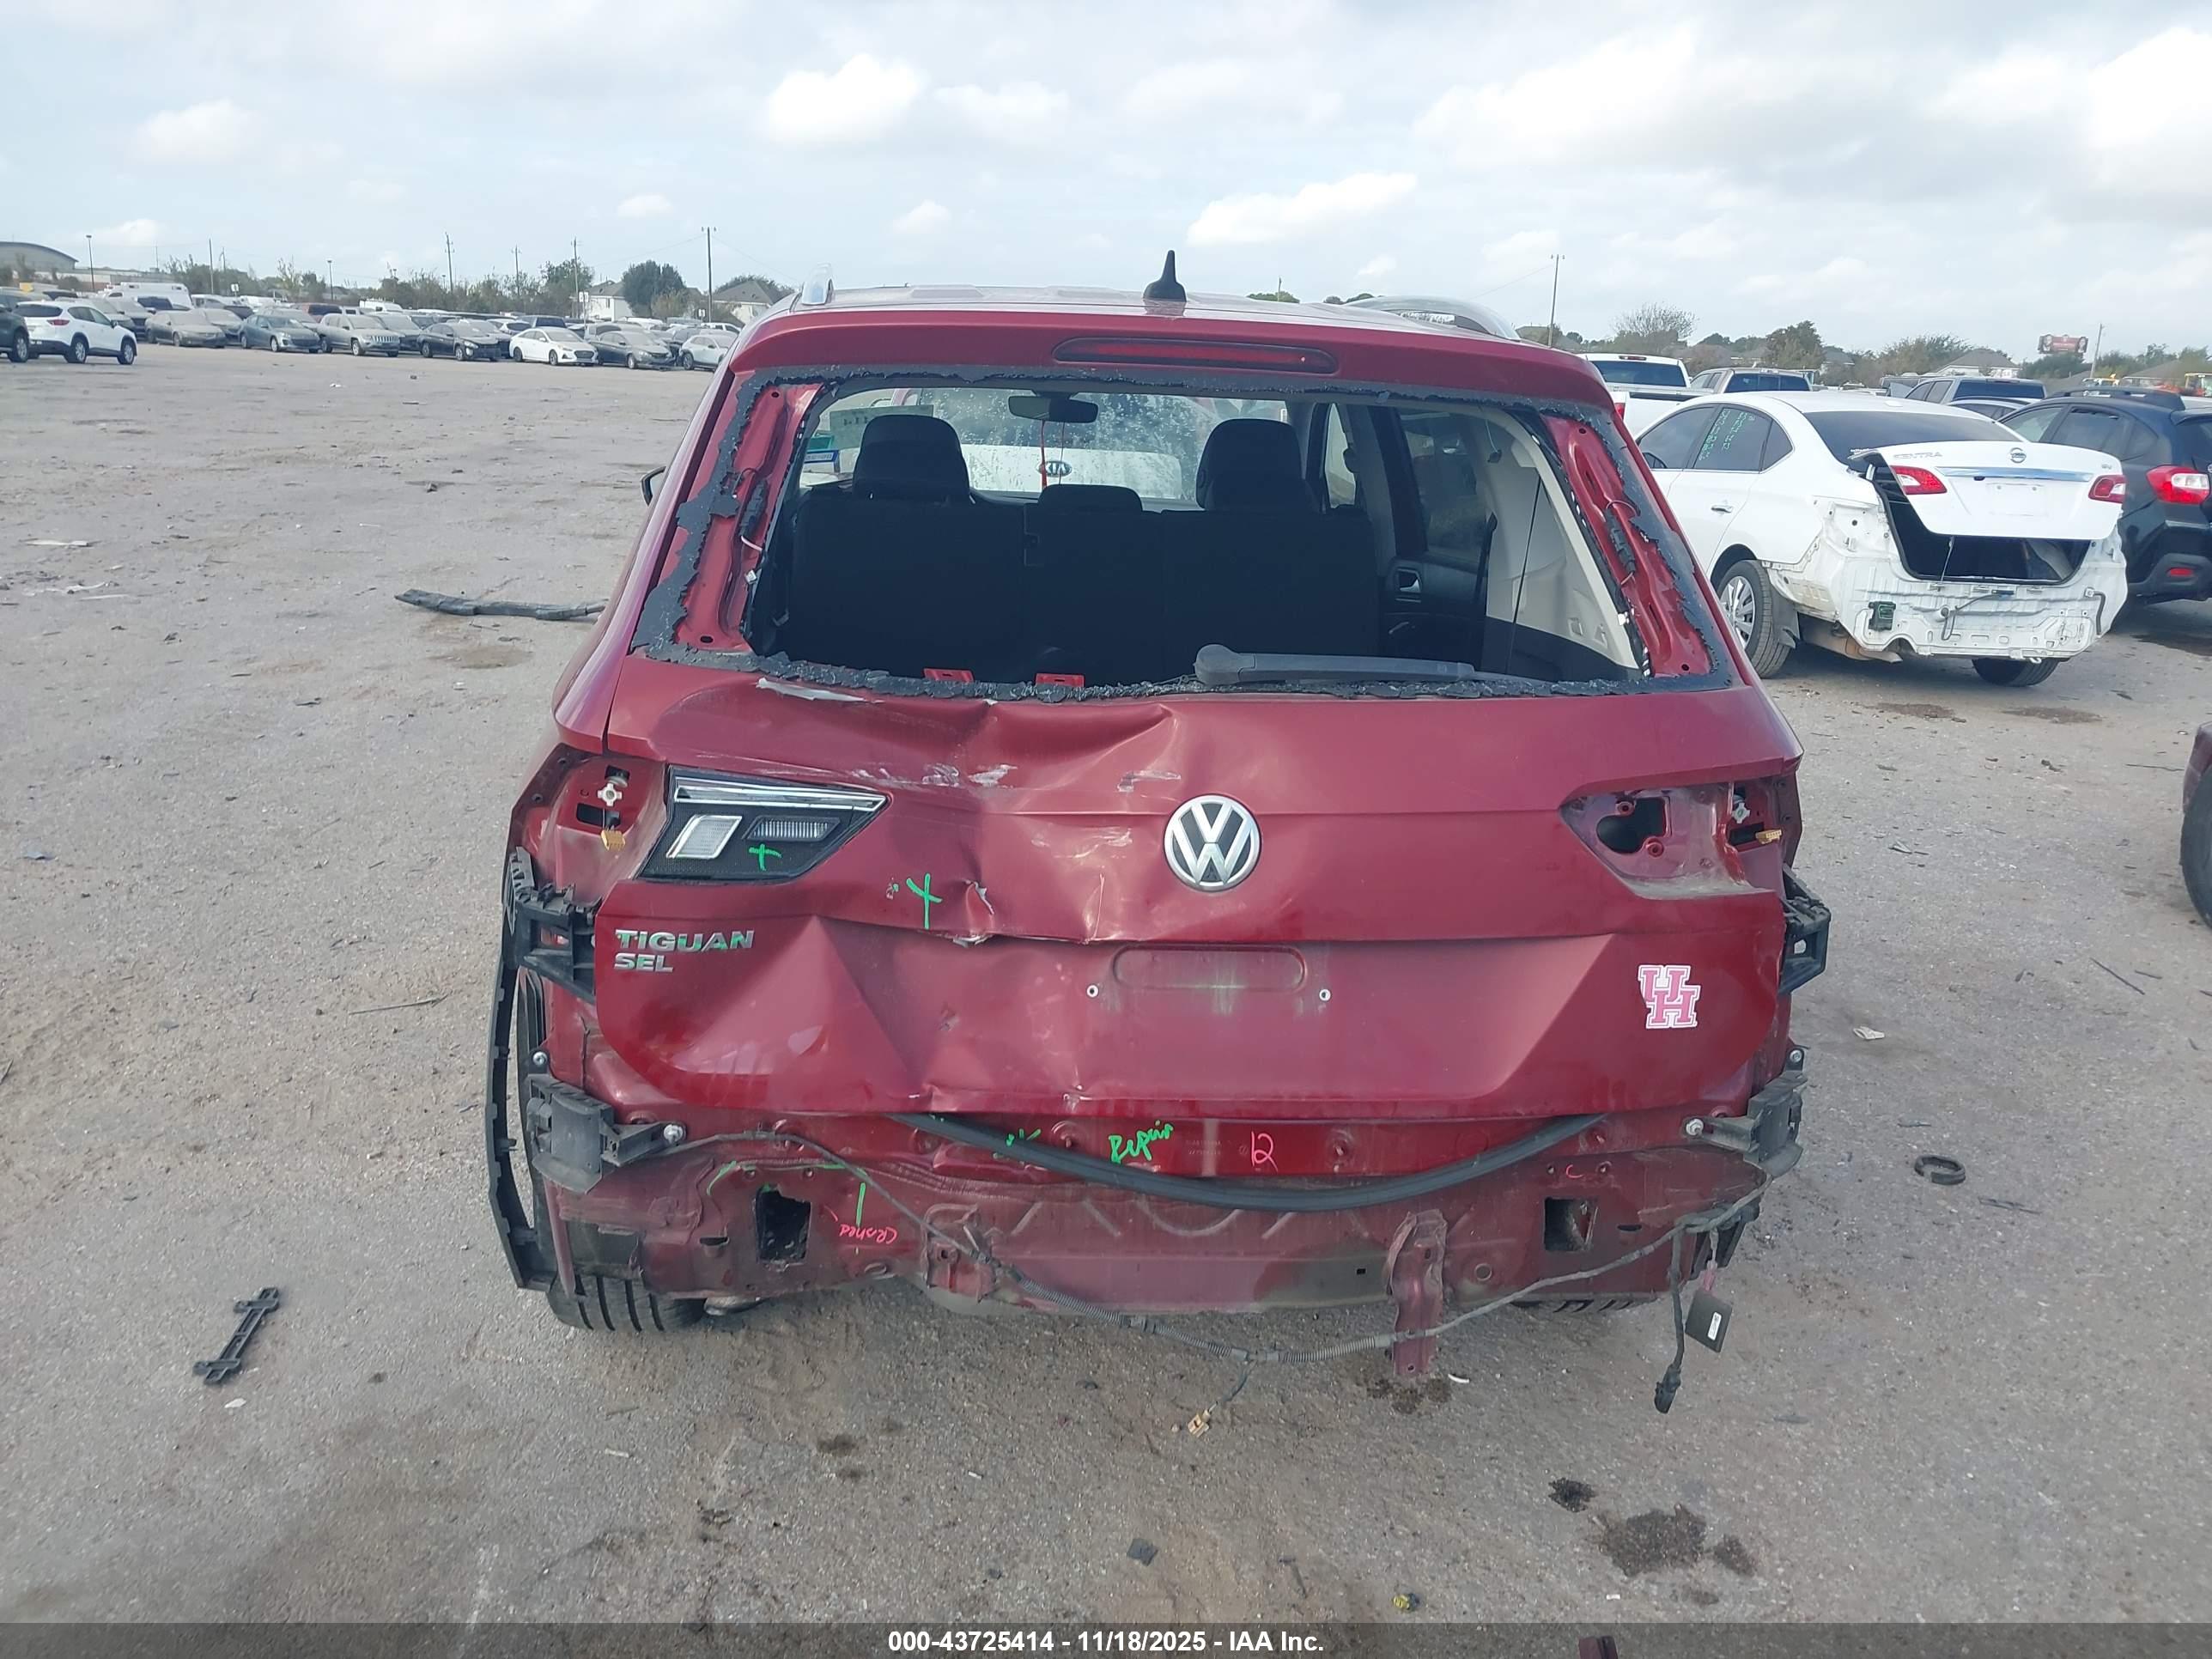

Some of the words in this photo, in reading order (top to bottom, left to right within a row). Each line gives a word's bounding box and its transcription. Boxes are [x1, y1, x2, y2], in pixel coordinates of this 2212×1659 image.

[1165, 795, 1261, 890] VW
[614, 929, 755, 952] TIGUAN
[614, 952, 674, 973] SEL
[1638, 965, 1701, 1029] UH
